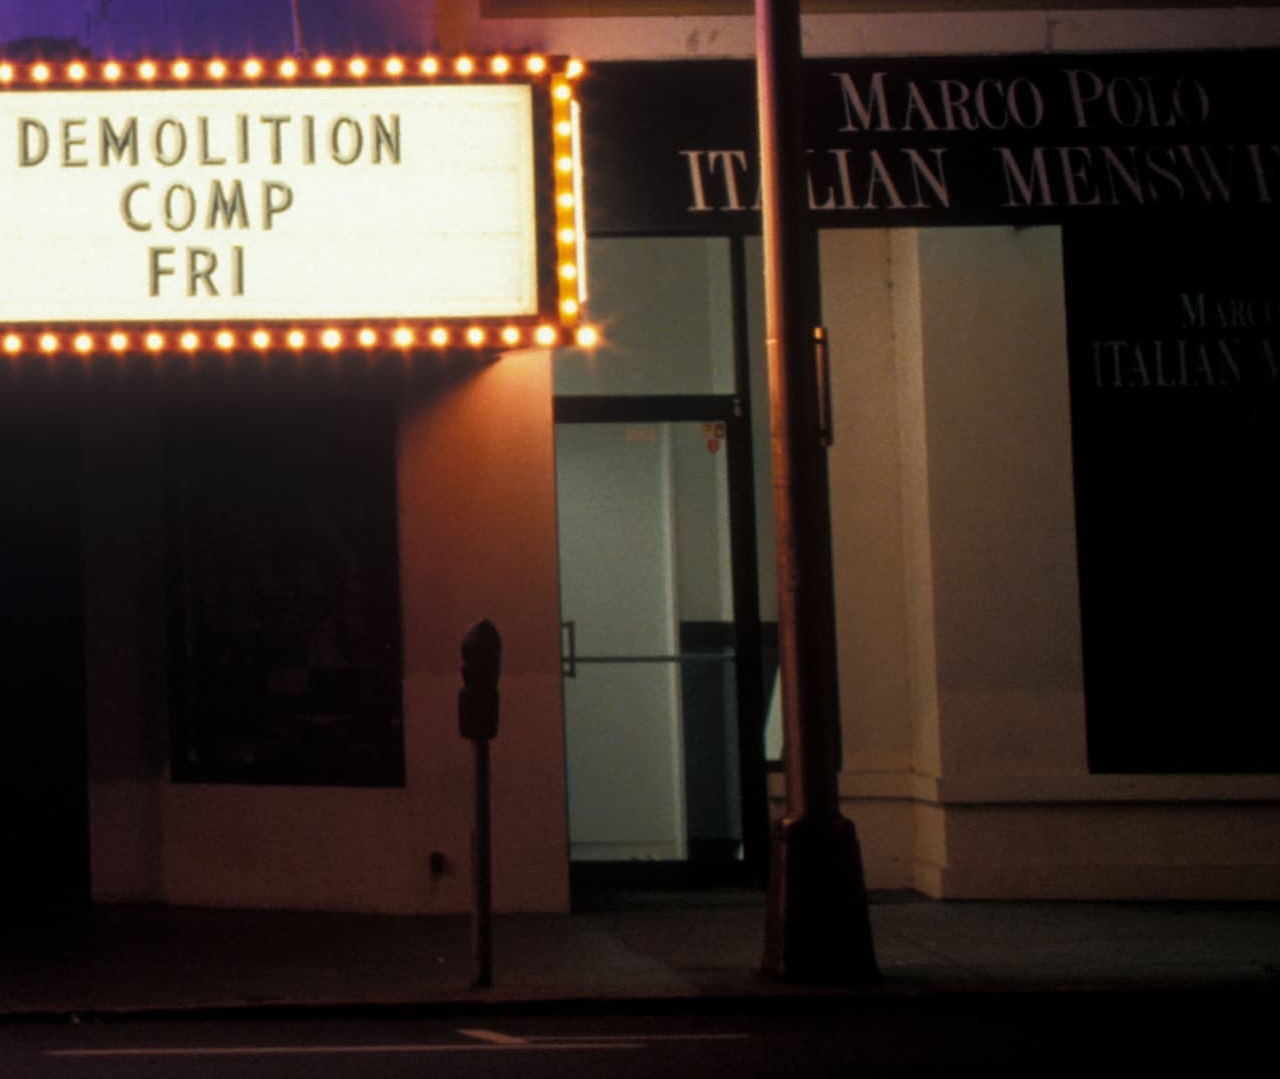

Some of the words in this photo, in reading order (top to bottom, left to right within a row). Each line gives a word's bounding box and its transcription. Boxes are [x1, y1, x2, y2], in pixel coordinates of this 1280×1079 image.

[829, 71, 1046, 133] MARCO
[1060, 67, 1211, 129] POLO
[17, 113, 403, 168] DEMOLITION
[120, 178, 296, 232] COMP
[678, 146, 952, 211] ITLIAN
[147, 244, 246, 297] FRI
[1090, 337, 1242, 390] ITALIAN
